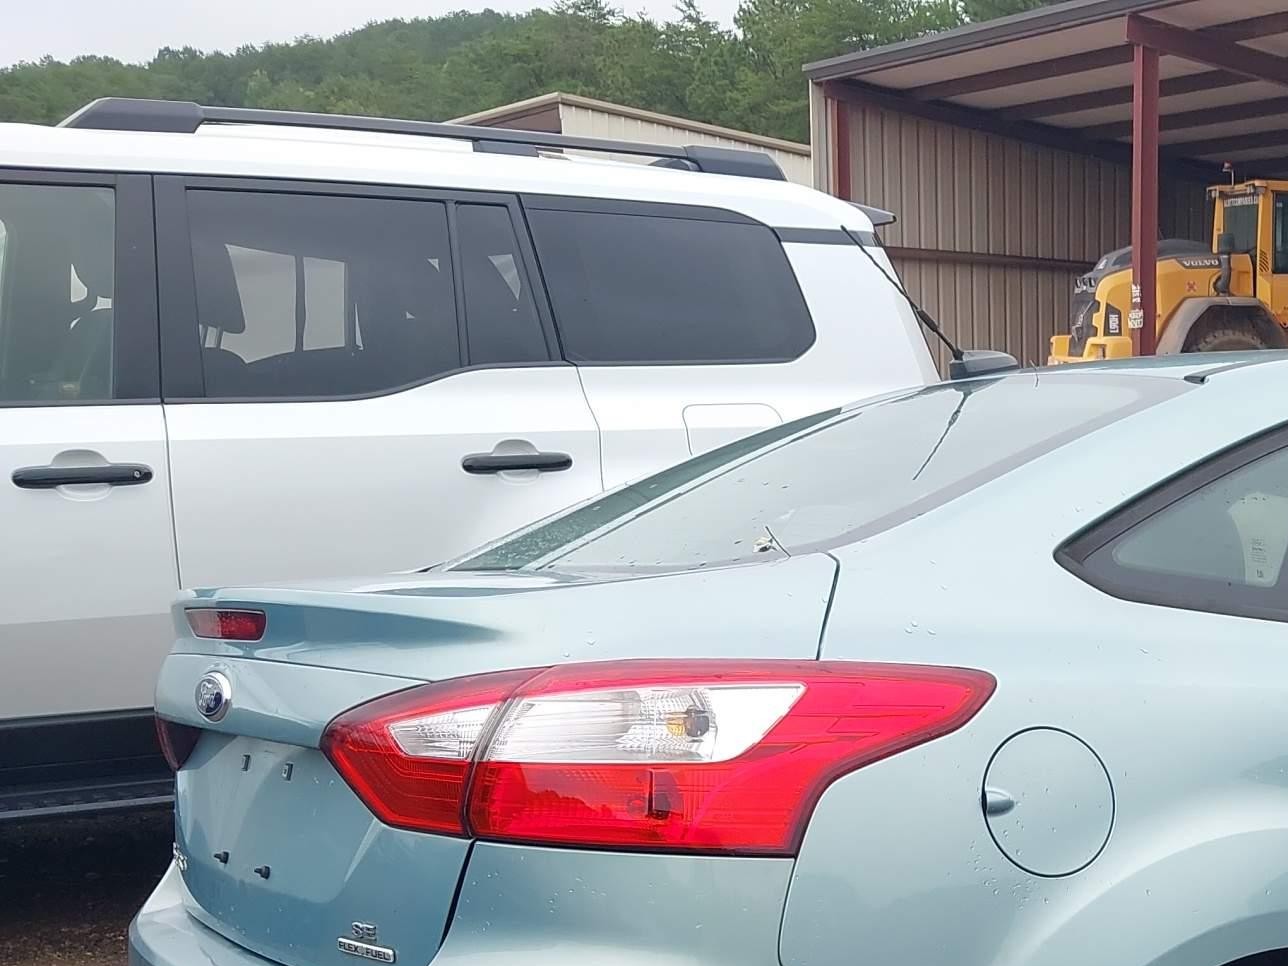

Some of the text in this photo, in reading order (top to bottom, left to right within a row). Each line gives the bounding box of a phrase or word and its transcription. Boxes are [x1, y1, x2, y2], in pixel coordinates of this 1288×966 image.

[1182, 258, 1219, 267] VOLVO
[351, 921, 377, 940] SE
[338, 940, 392, 961] FLEX FUEL
